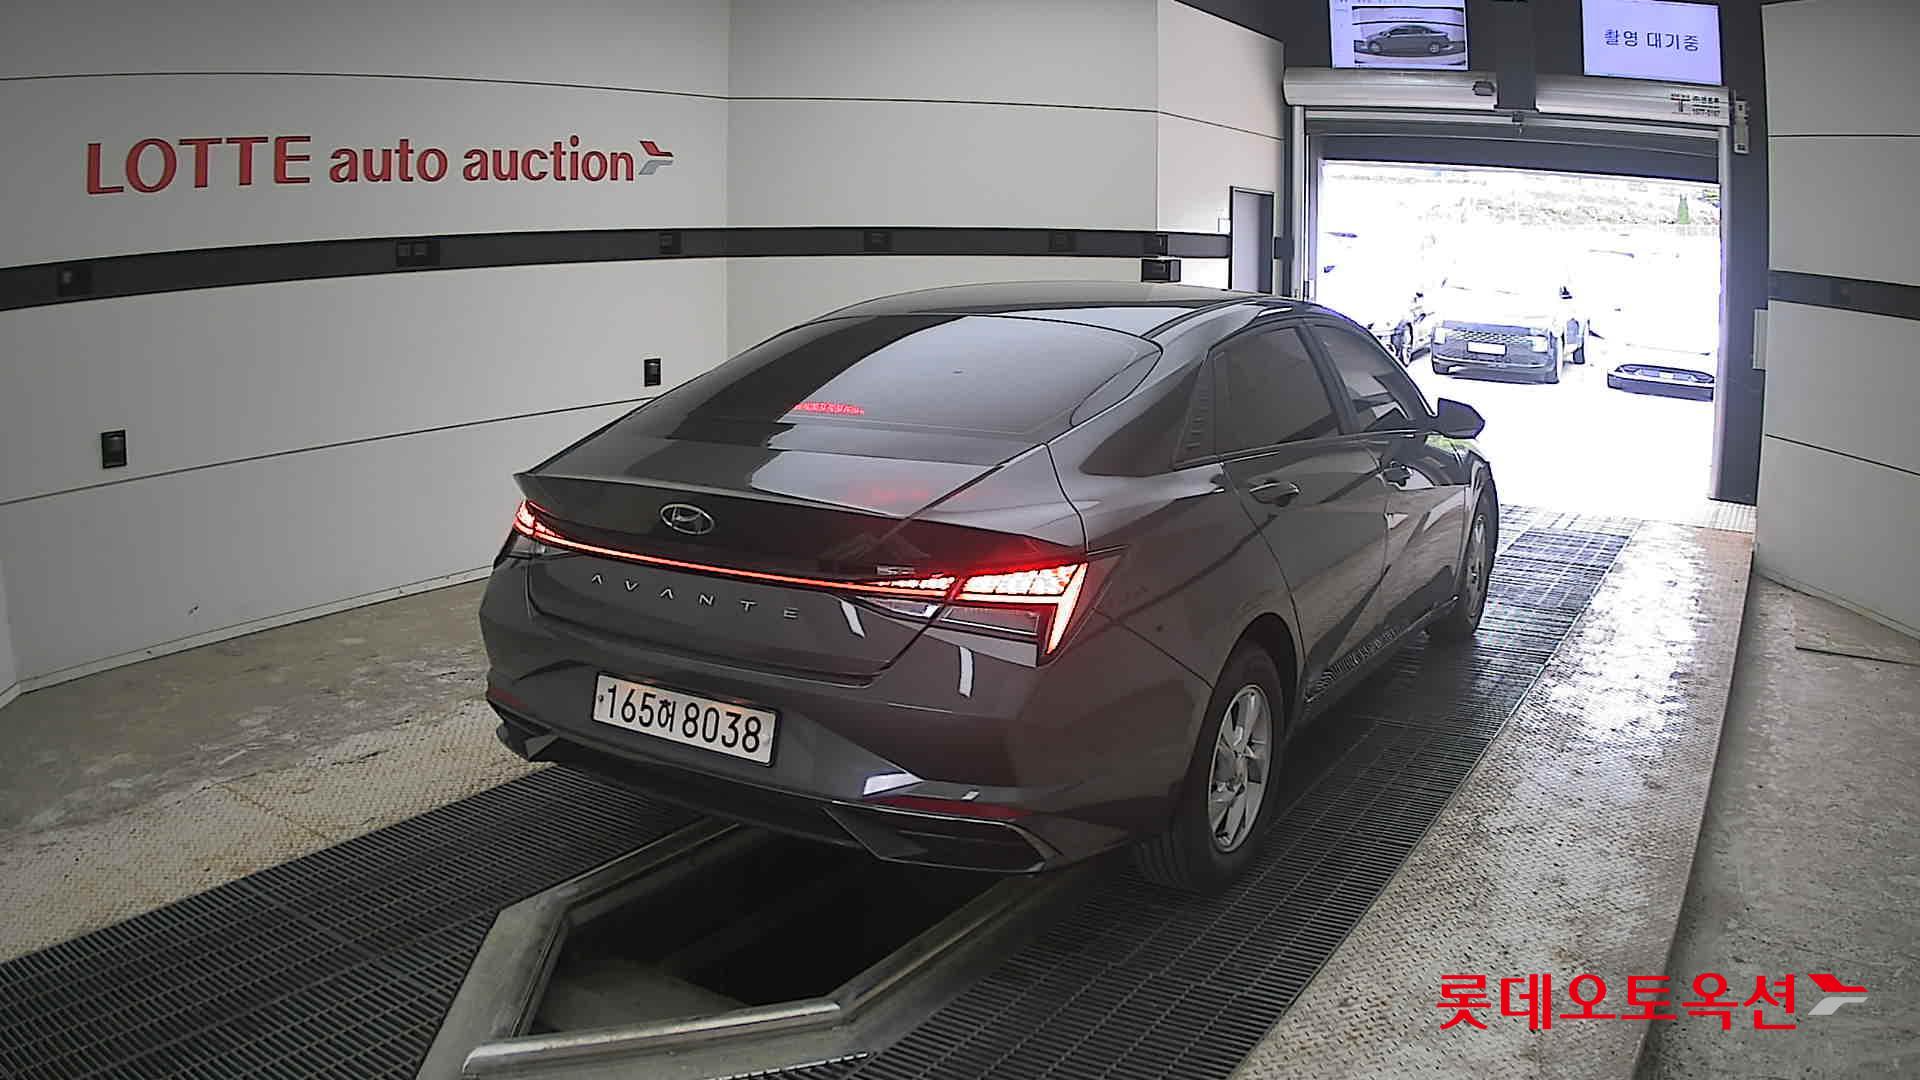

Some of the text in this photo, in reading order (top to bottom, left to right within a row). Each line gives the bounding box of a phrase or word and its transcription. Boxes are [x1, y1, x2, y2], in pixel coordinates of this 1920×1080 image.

[1604, 28, 1699, 52] 촬영 대기중
[87, 134, 634, 195] LOTTE auto auction
[591, 573, 799, 620] AVANTE
